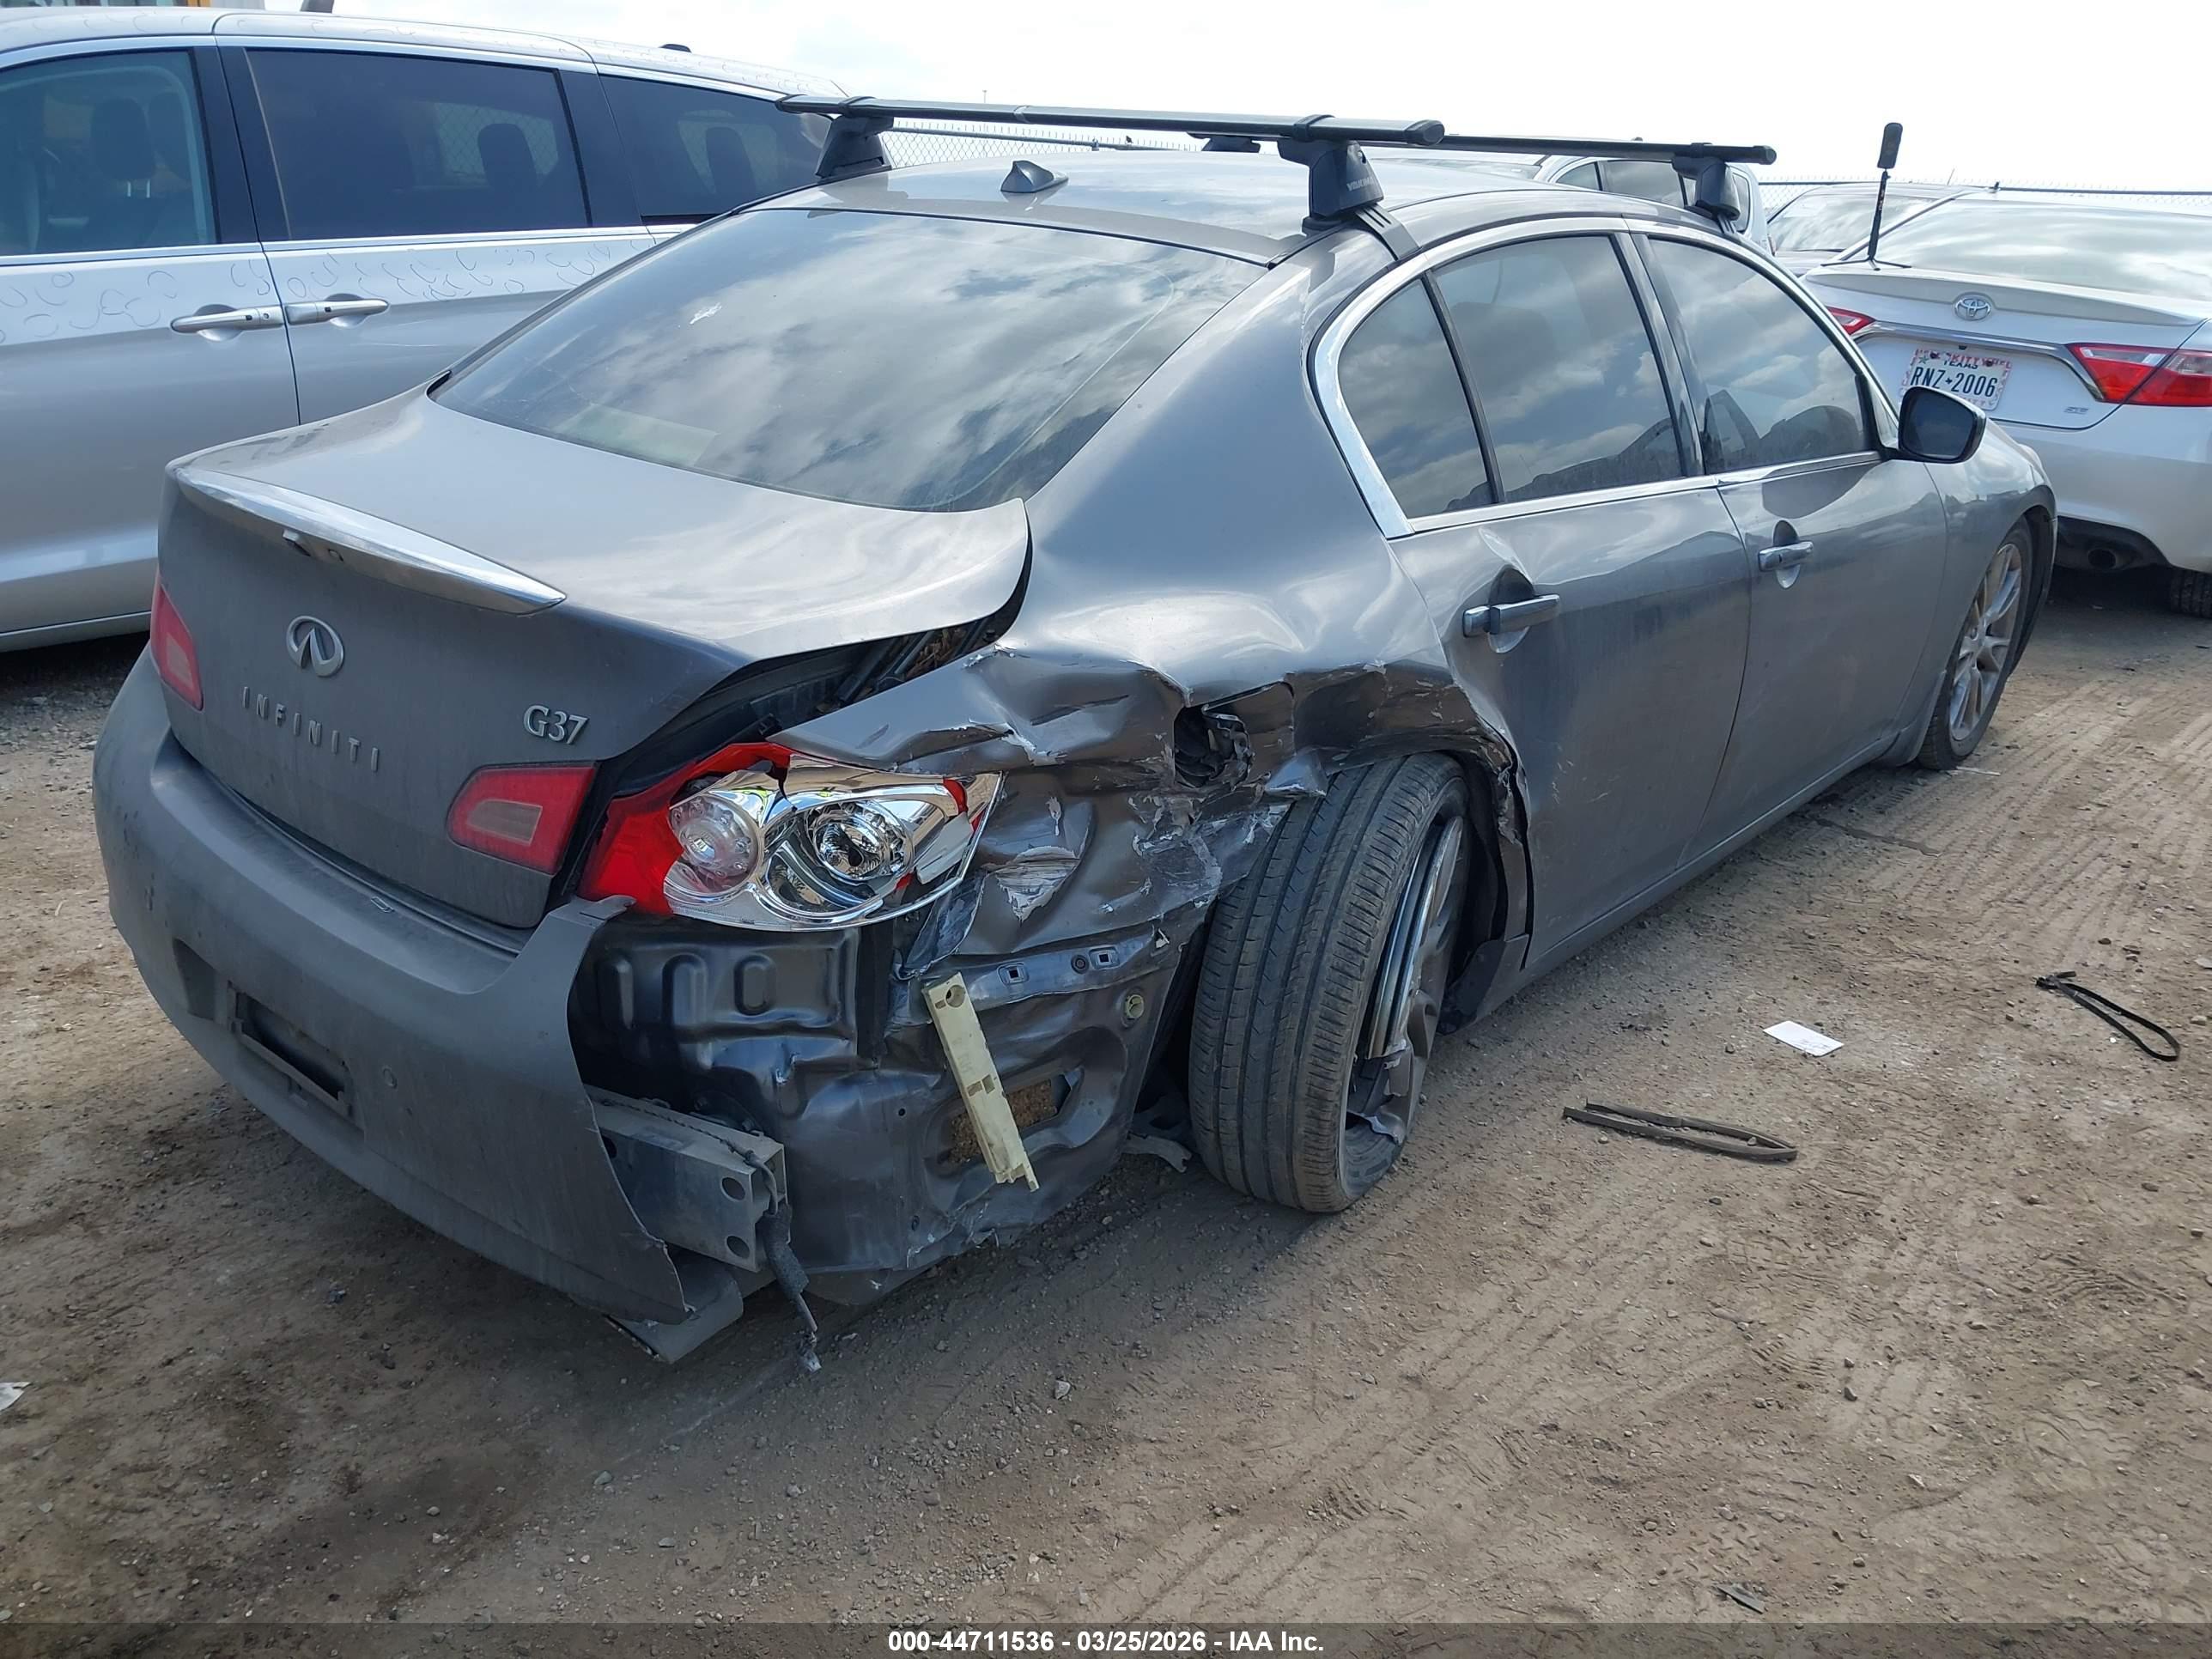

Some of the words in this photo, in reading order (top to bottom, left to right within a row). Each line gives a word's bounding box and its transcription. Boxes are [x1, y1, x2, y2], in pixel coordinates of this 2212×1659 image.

[1951, 373, 1998, 398] 2006
[241, 686, 380, 773] INFINITI
[523, 704, 589, 745] G37
